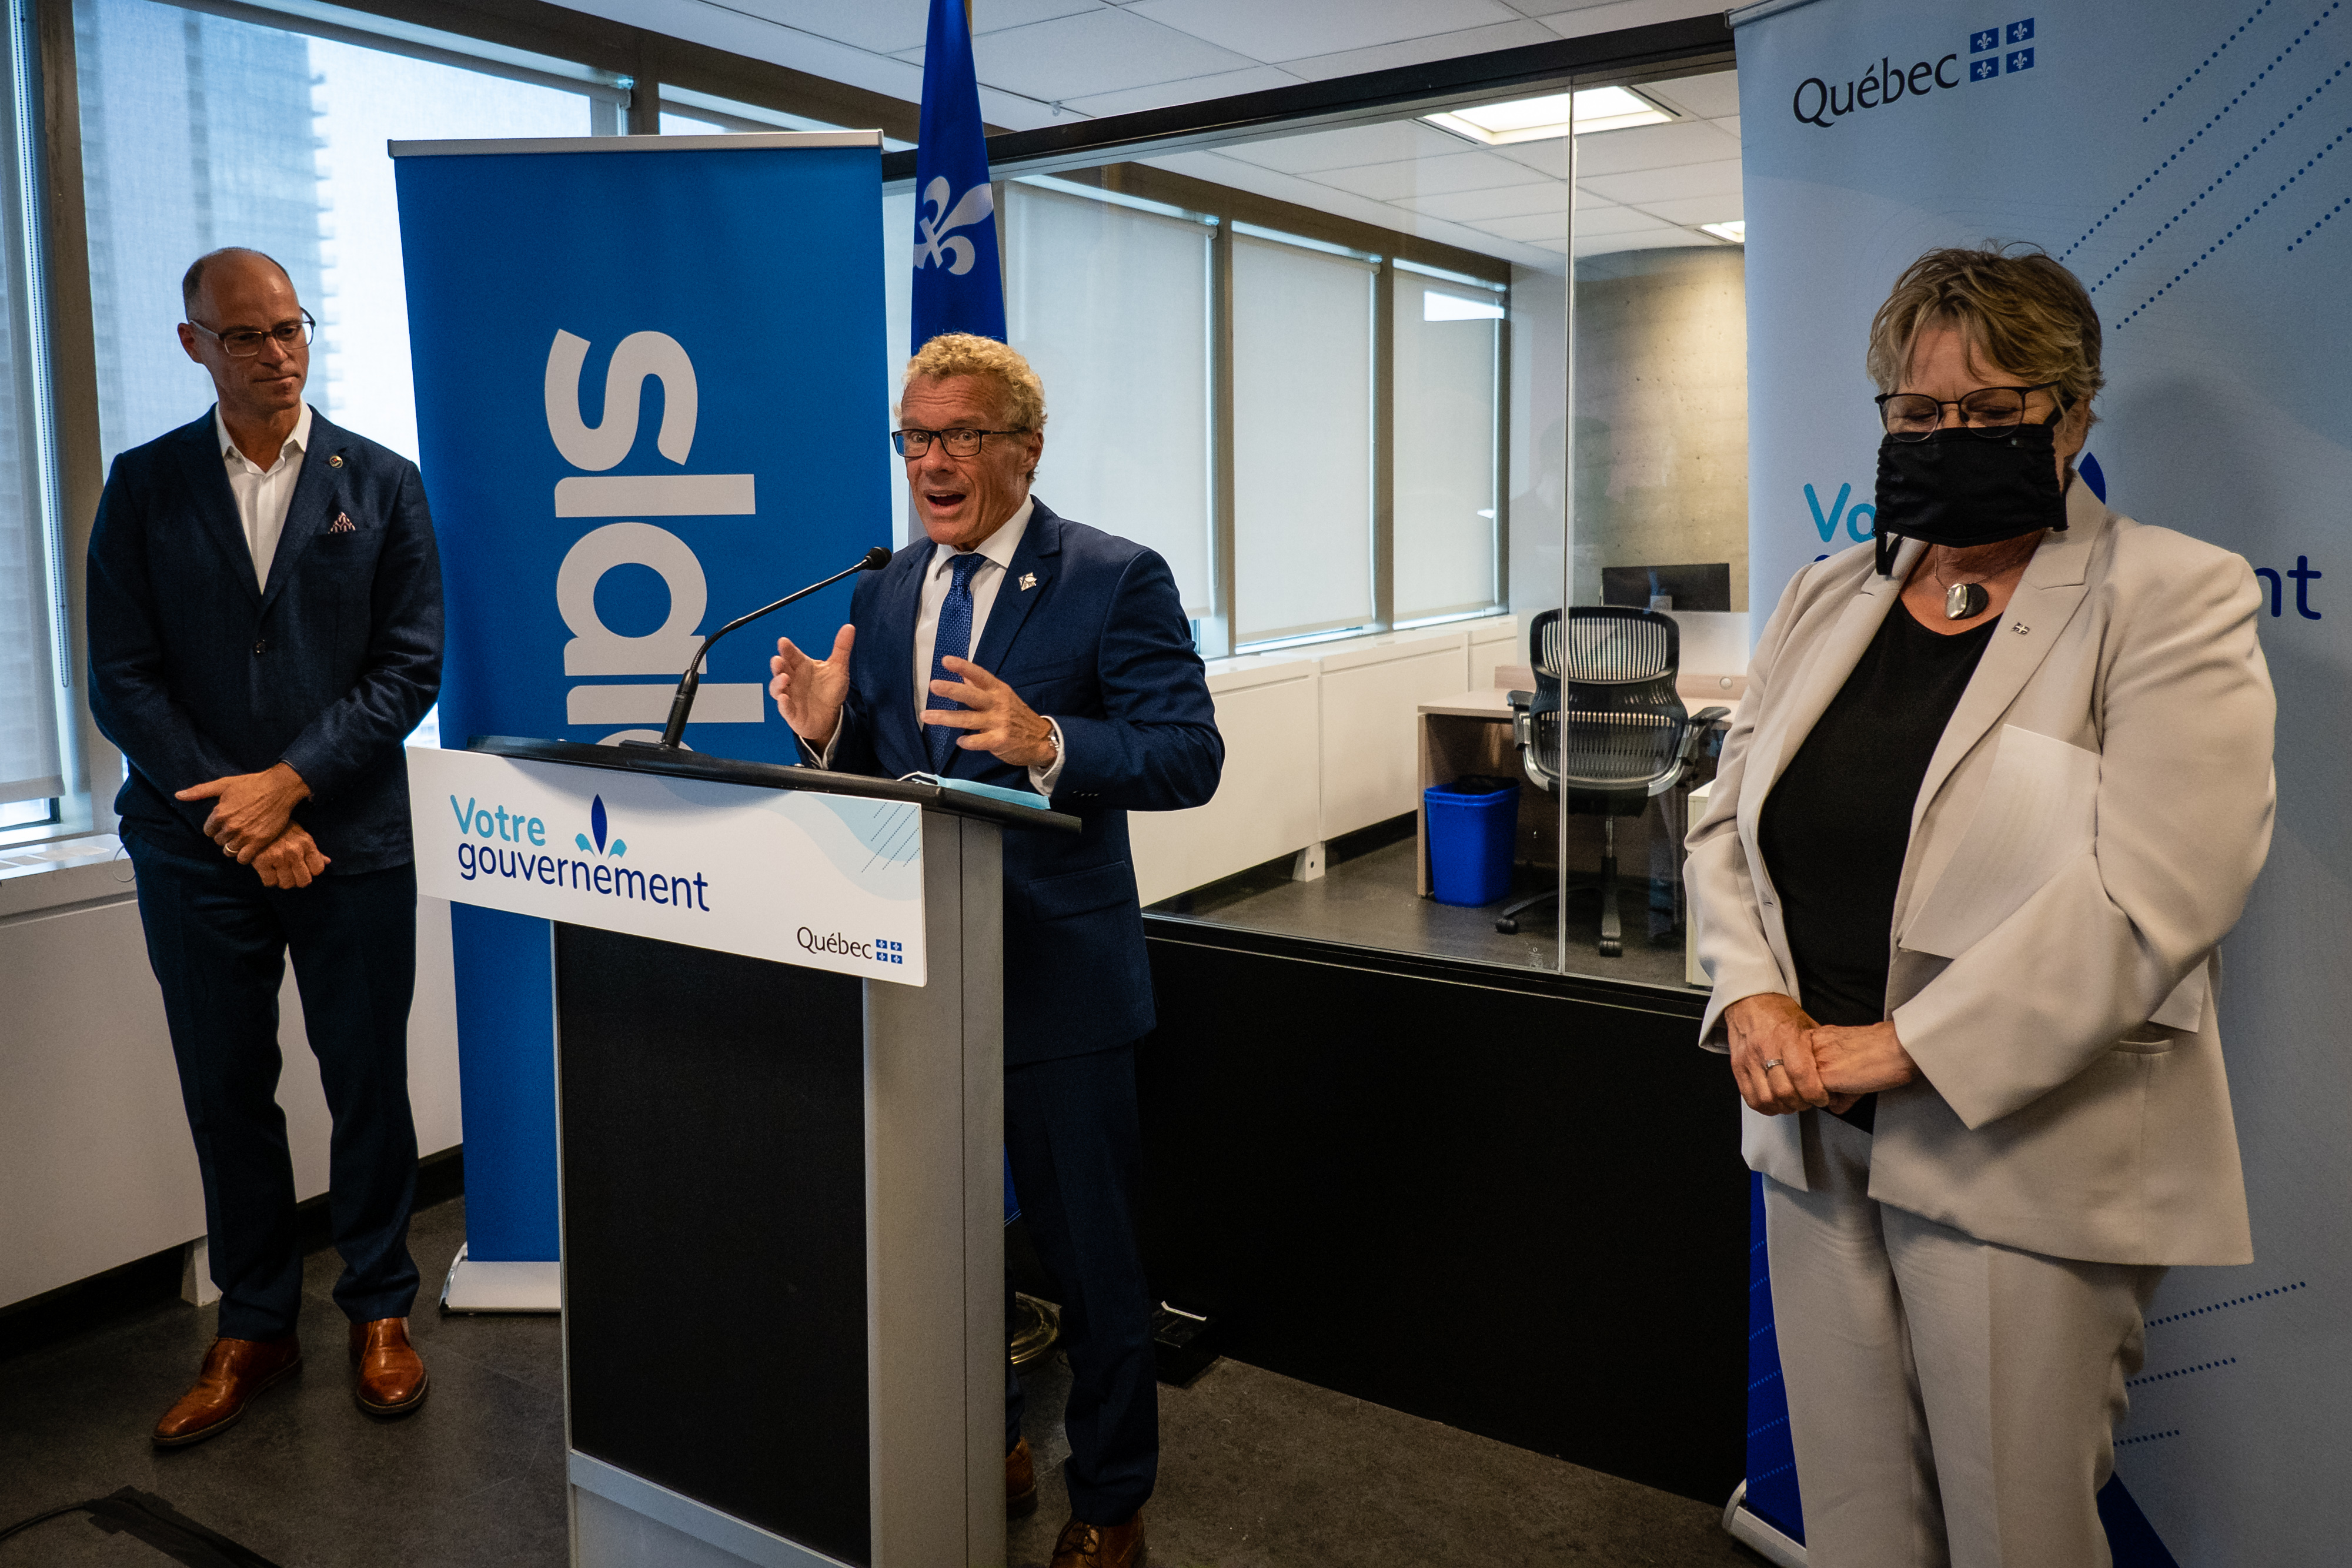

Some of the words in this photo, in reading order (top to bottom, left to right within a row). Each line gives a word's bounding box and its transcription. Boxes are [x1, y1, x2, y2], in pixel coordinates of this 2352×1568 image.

[1792, 52, 1961, 129] Québec
[544, 328, 765, 751] slal
[450, 794, 546, 847] Votre
[457, 842, 710, 912] gouvernement
[796, 926, 874, 960] Québec
